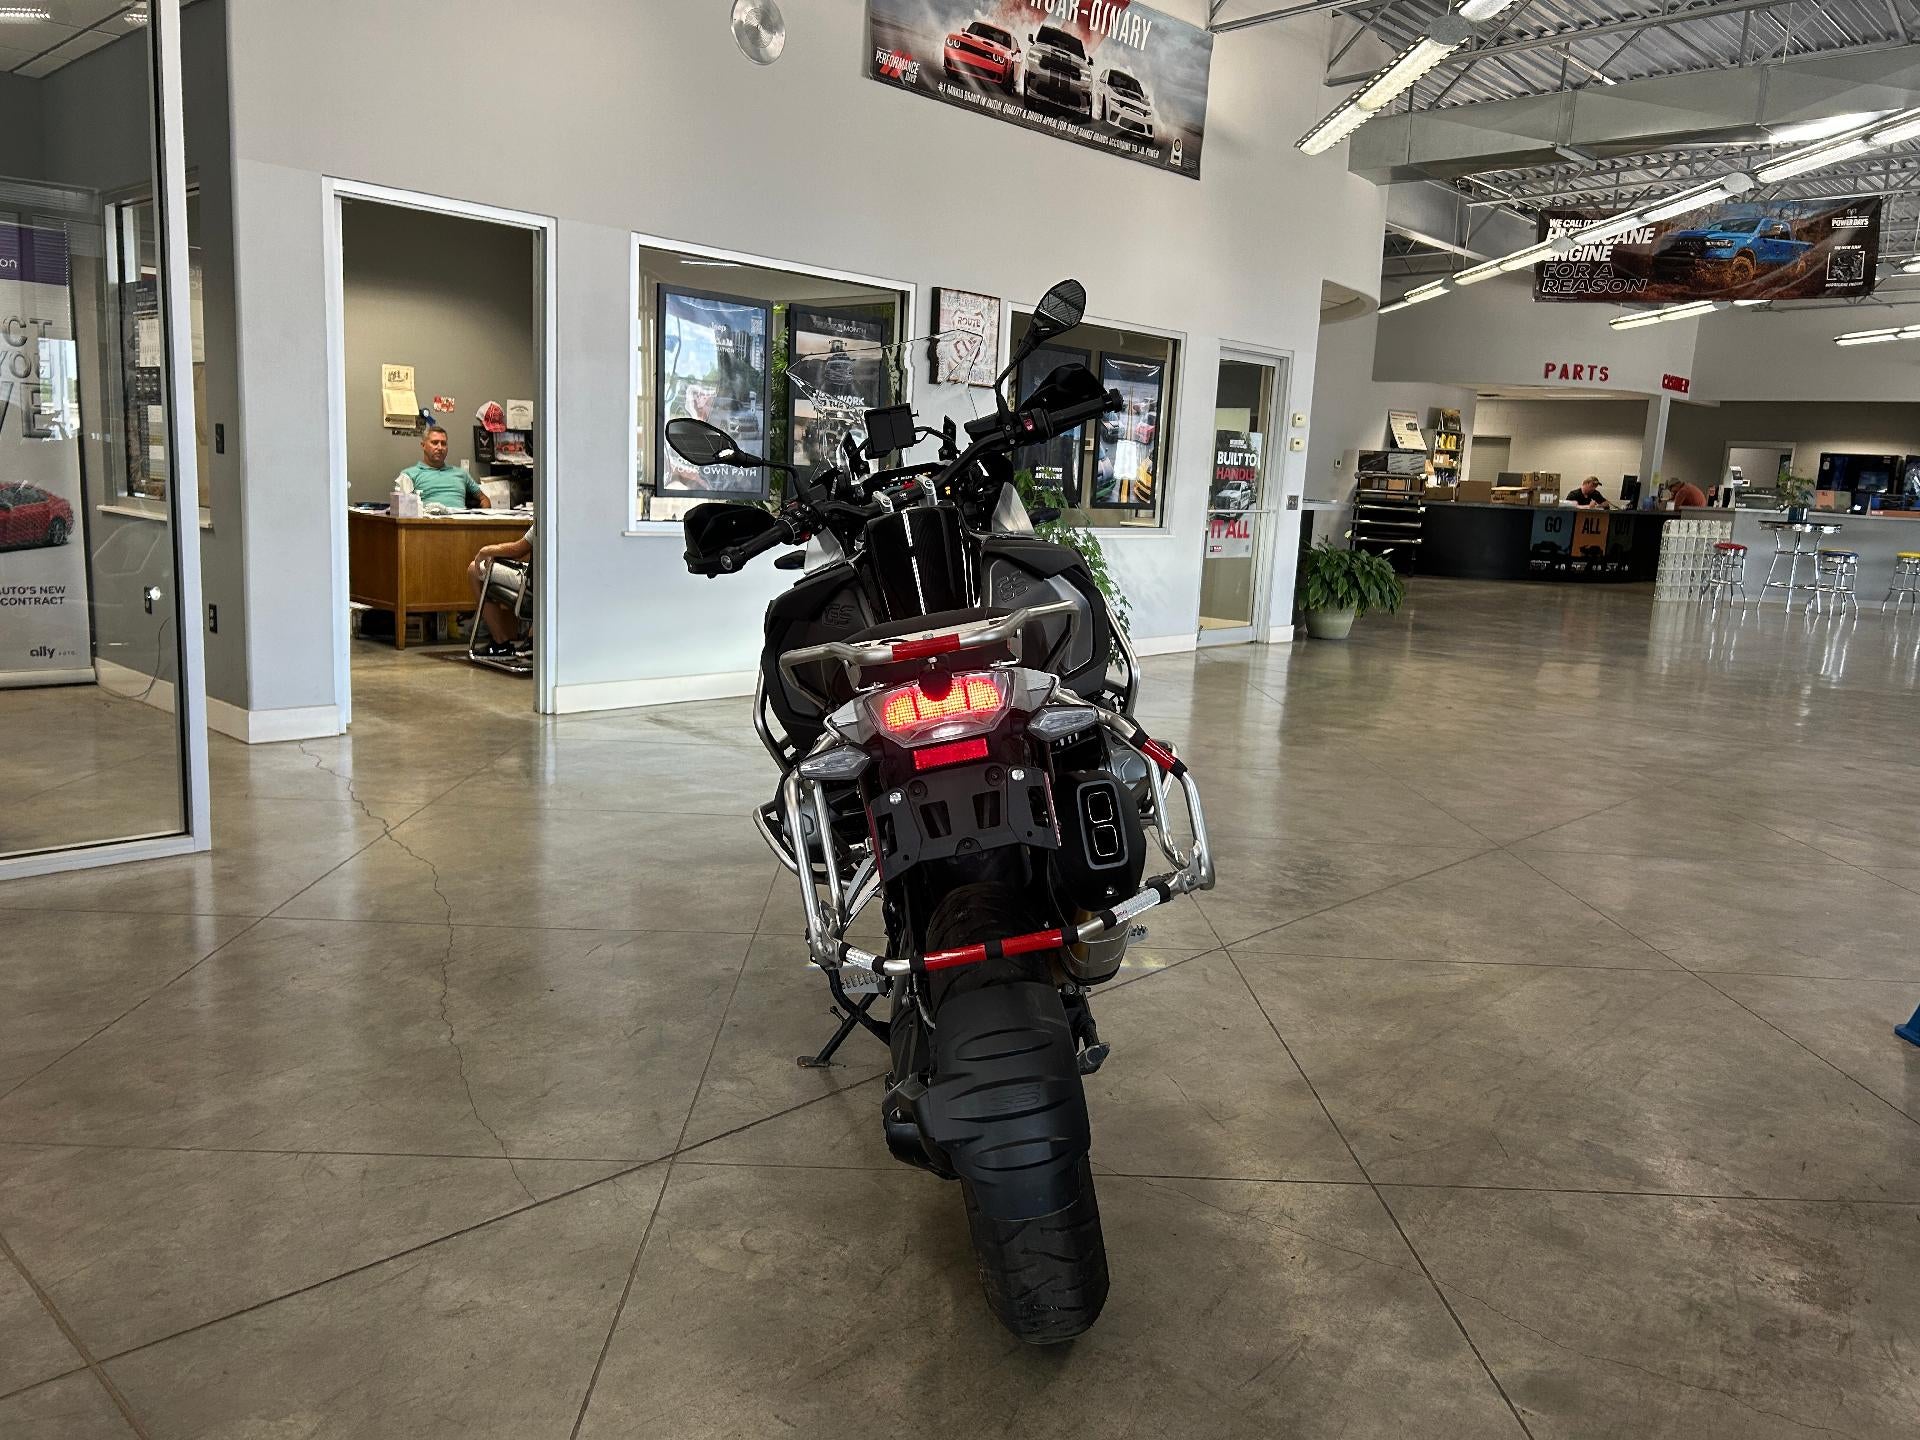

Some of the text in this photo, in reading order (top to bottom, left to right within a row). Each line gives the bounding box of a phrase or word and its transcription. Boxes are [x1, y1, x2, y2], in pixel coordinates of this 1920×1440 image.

[875, 50, 920, 74] PERFORMANCE
[1563, 219, 1583, 228] CALL
[1545, 245, 1614, 262] NGINE
[1543, 263, 1614, 279] FOR A
[1541, 278, 1649, 294] REASON
[957, 316, 981, 328] ROUTE
[1544, 362, 1609, 382] PARTS
[1217, 451, 1257, 467] BUILT TO
[703, 466, 729, 476] OWN
[731, 468, 757, 477] PATH
[1216, 466, 1257, 481] HANDLE
[1209, 519, 1250, 539] IT ALL
[1544, 516, 1562, 533] GO
[1581, 517, 1601, 534] ALL
[0, 585, 66, 595] UTO'S NEW
[0, 596, 65, 606] CONTRACT
[29, 645, 56, 659] ally
